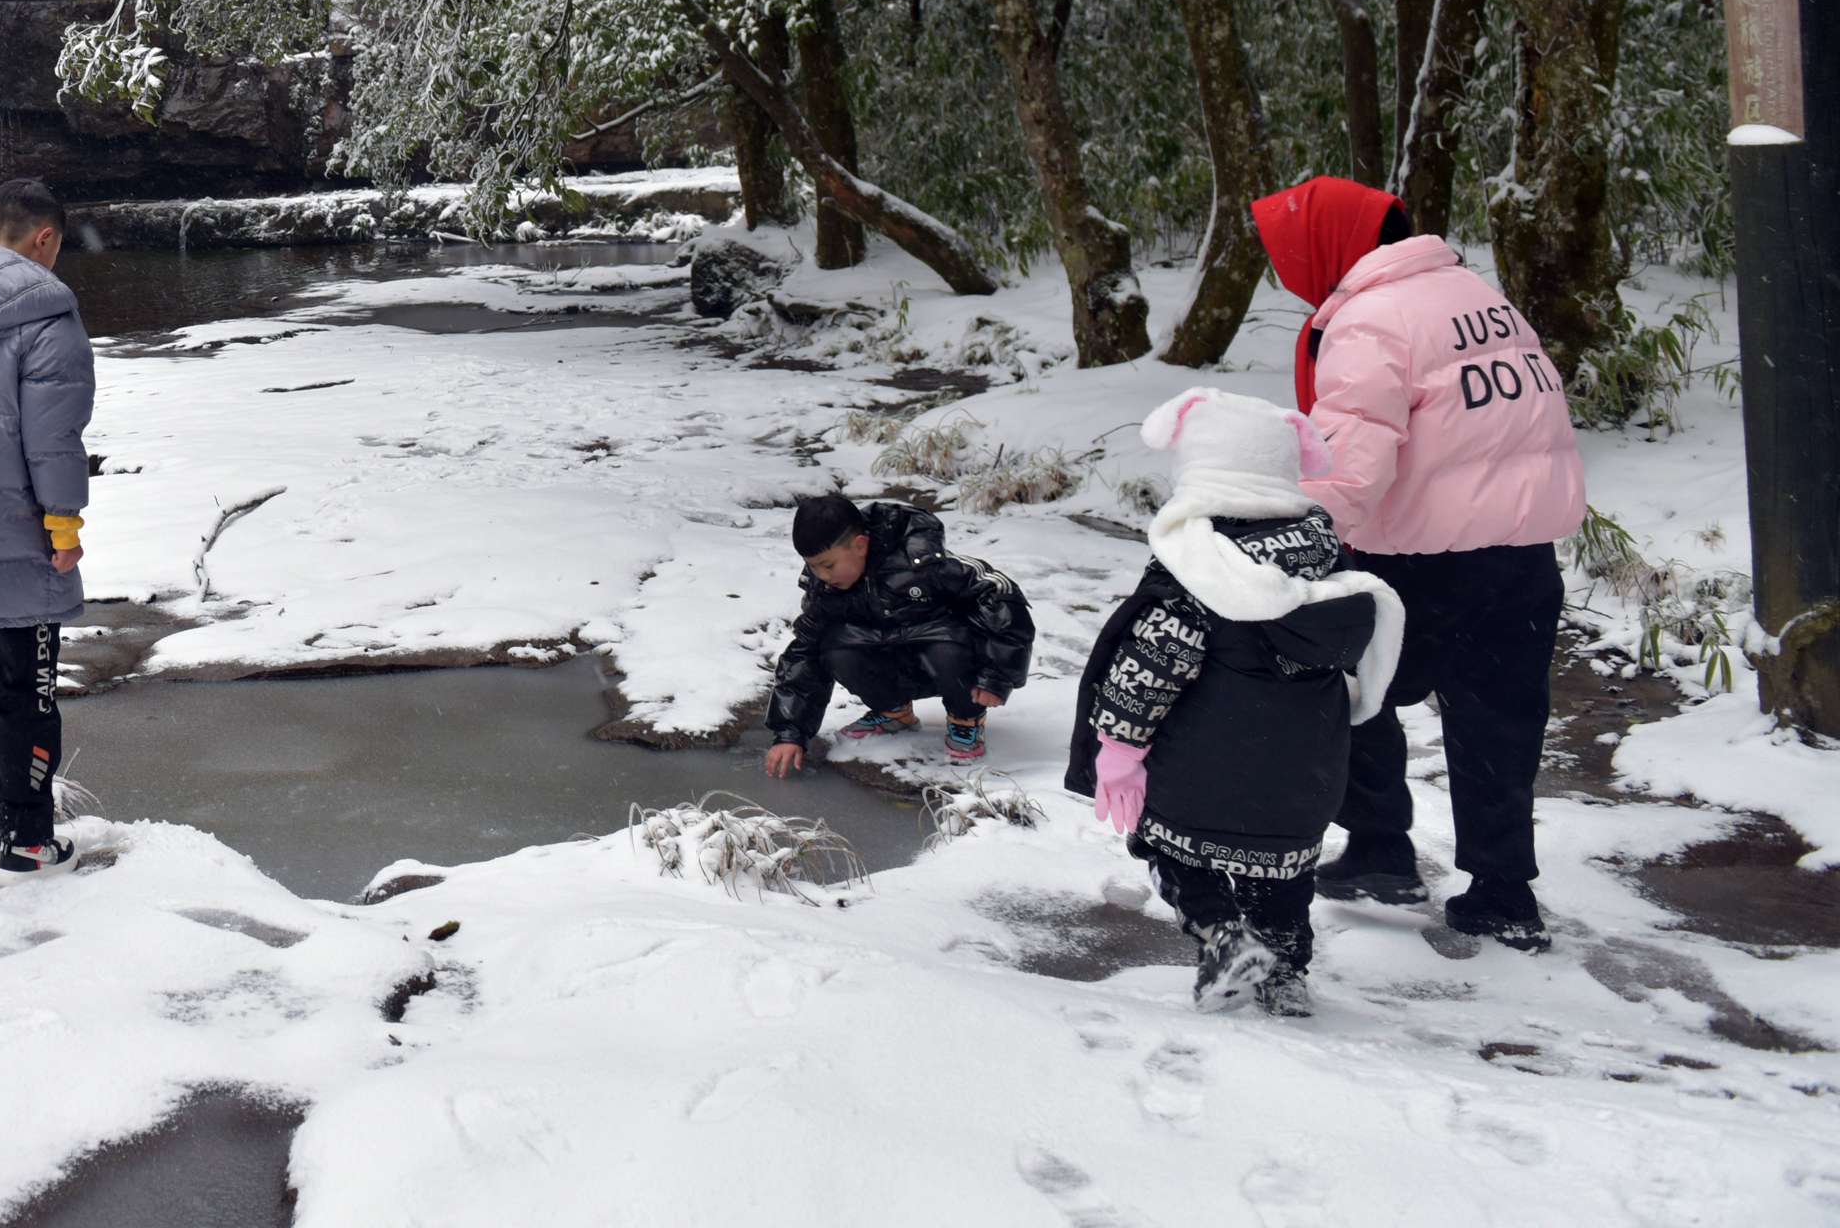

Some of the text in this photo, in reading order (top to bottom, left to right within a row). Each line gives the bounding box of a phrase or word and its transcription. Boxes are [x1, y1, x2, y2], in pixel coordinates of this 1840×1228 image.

[1452, 305, 1519, 351] JUST
[1460, 360, 1522, 410] DO
[1147, 608, 1206, 651] PAUL
[1201, 841, 1277, 866] FRANK
